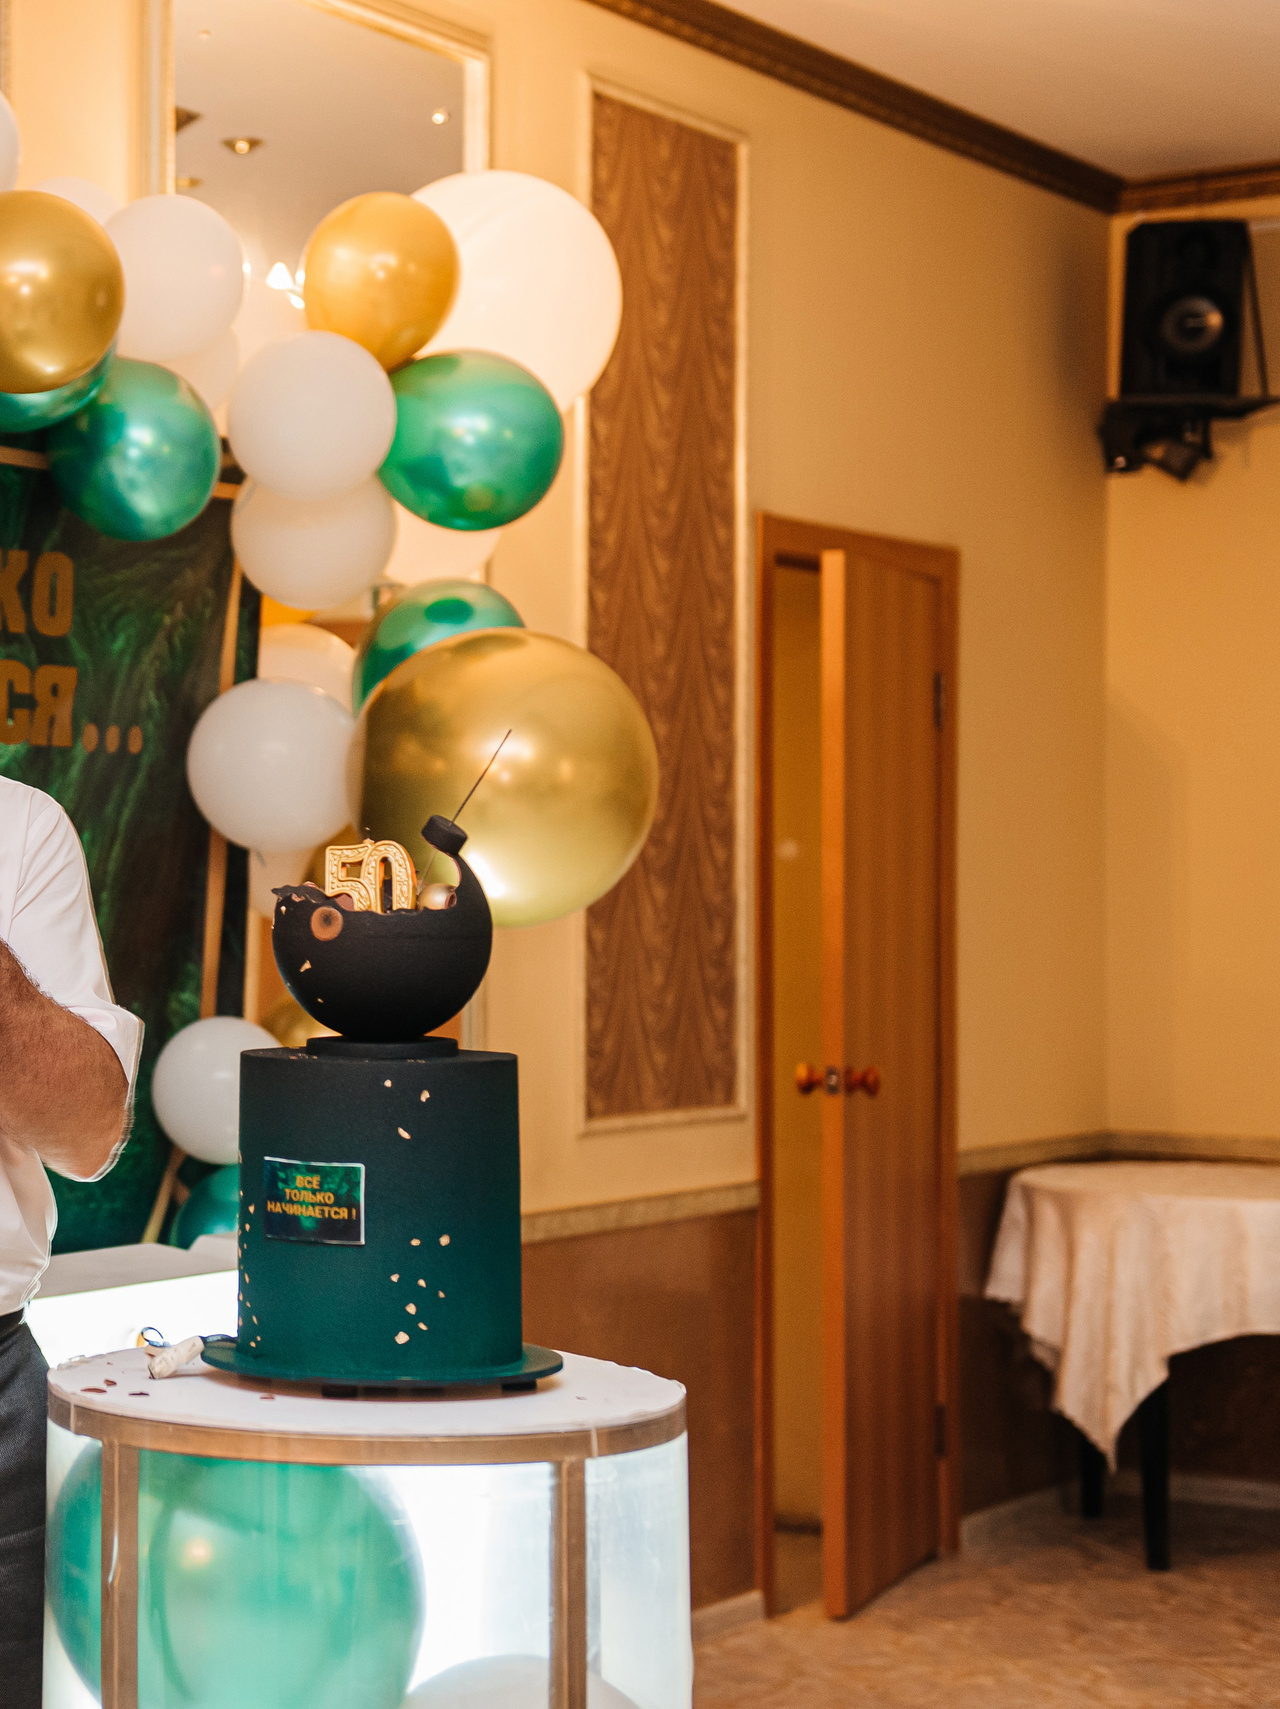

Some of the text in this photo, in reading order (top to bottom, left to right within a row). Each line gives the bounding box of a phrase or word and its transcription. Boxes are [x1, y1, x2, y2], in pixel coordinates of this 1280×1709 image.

[325, 839, 417, 914] 50
[284, 1188, 335, 1205] ТОЛЬКО
[266, 1200, 348, 1220] НАЧИНАЕТСЯ
